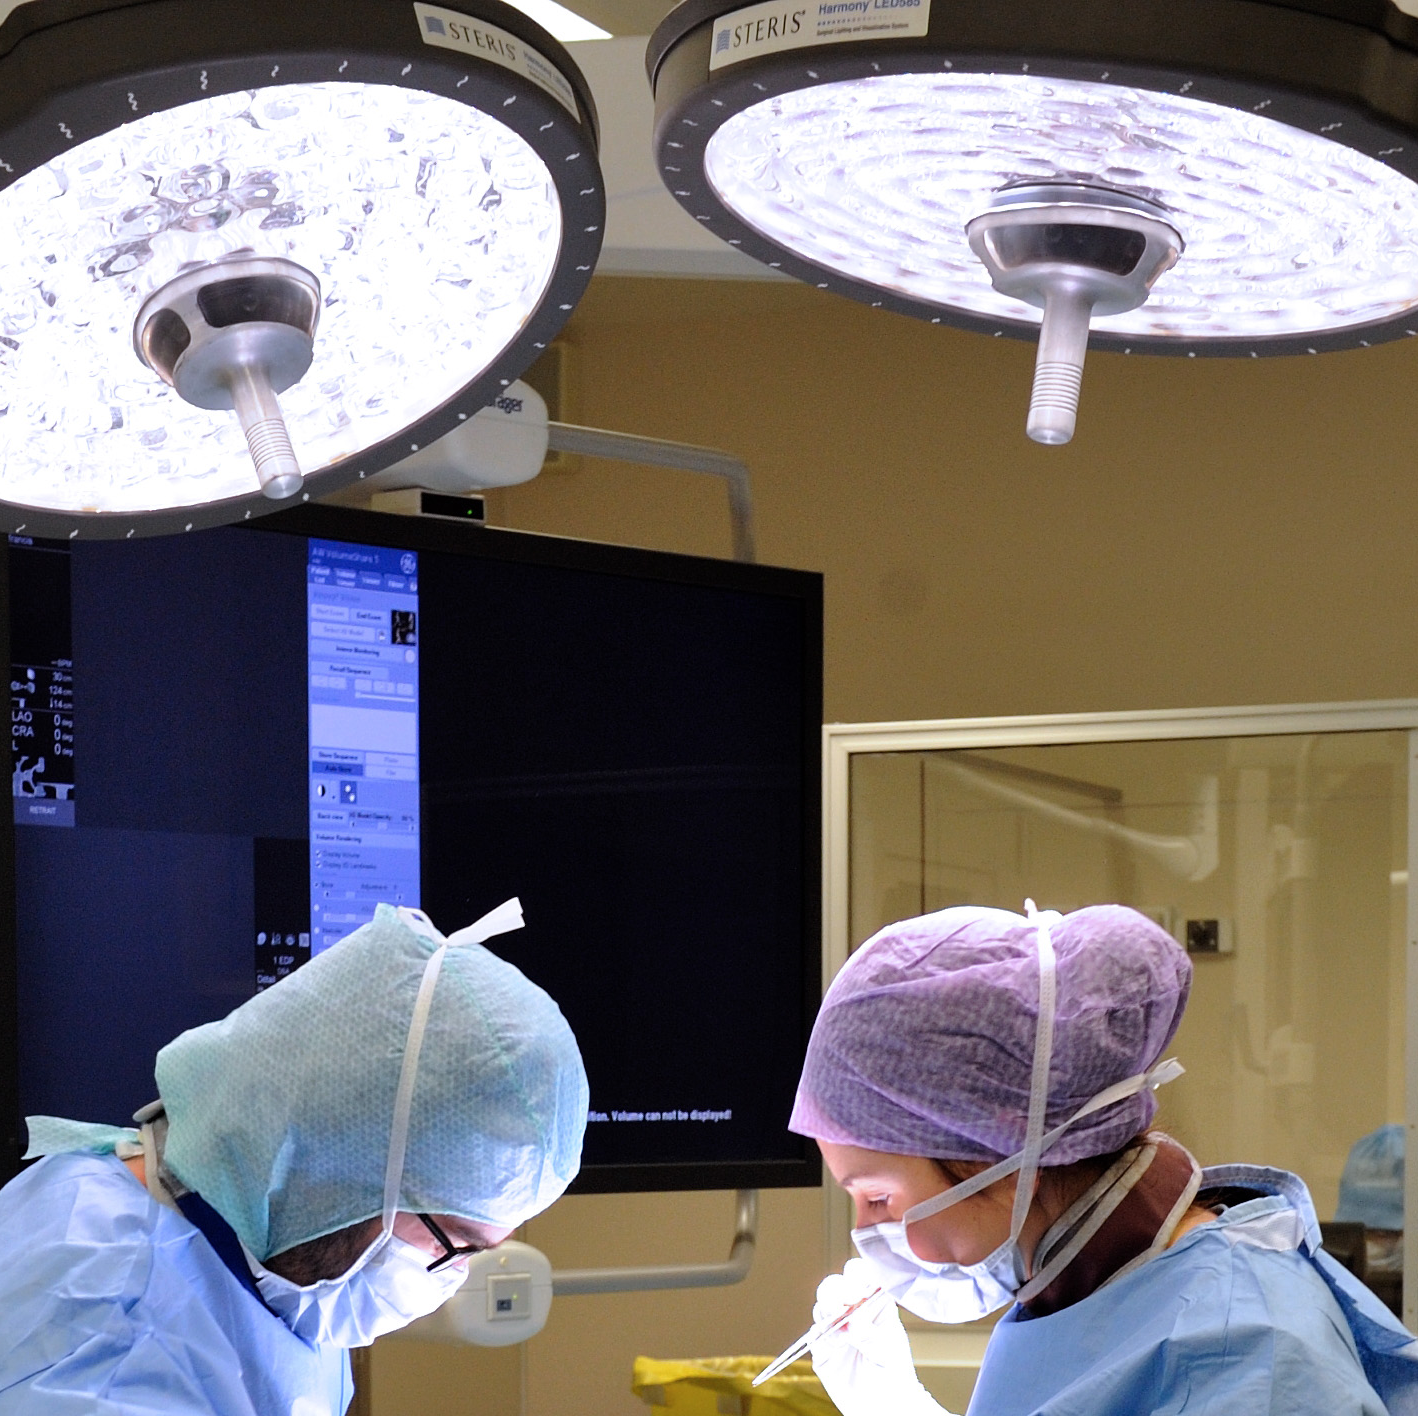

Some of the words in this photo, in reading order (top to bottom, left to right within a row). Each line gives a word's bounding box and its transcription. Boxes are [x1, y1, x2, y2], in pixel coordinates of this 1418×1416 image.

[818, 3, 869, 15] Harmony
[733, 11, 803, 48] STERIS
[449, 22, 516, 61] STERIS
[12, 711, 32, 723] LAO
[12, 726, 34, 738] CRA
[12, 740, 18, 751] L
[611, 1110, 644, 1121] Volume
[645, 1111, 661, 1121] can
[662, 1110, 677, 1121] not
[677, 1110, 688, 1121] be
[689, 1109, 732, 1123] displayed!
